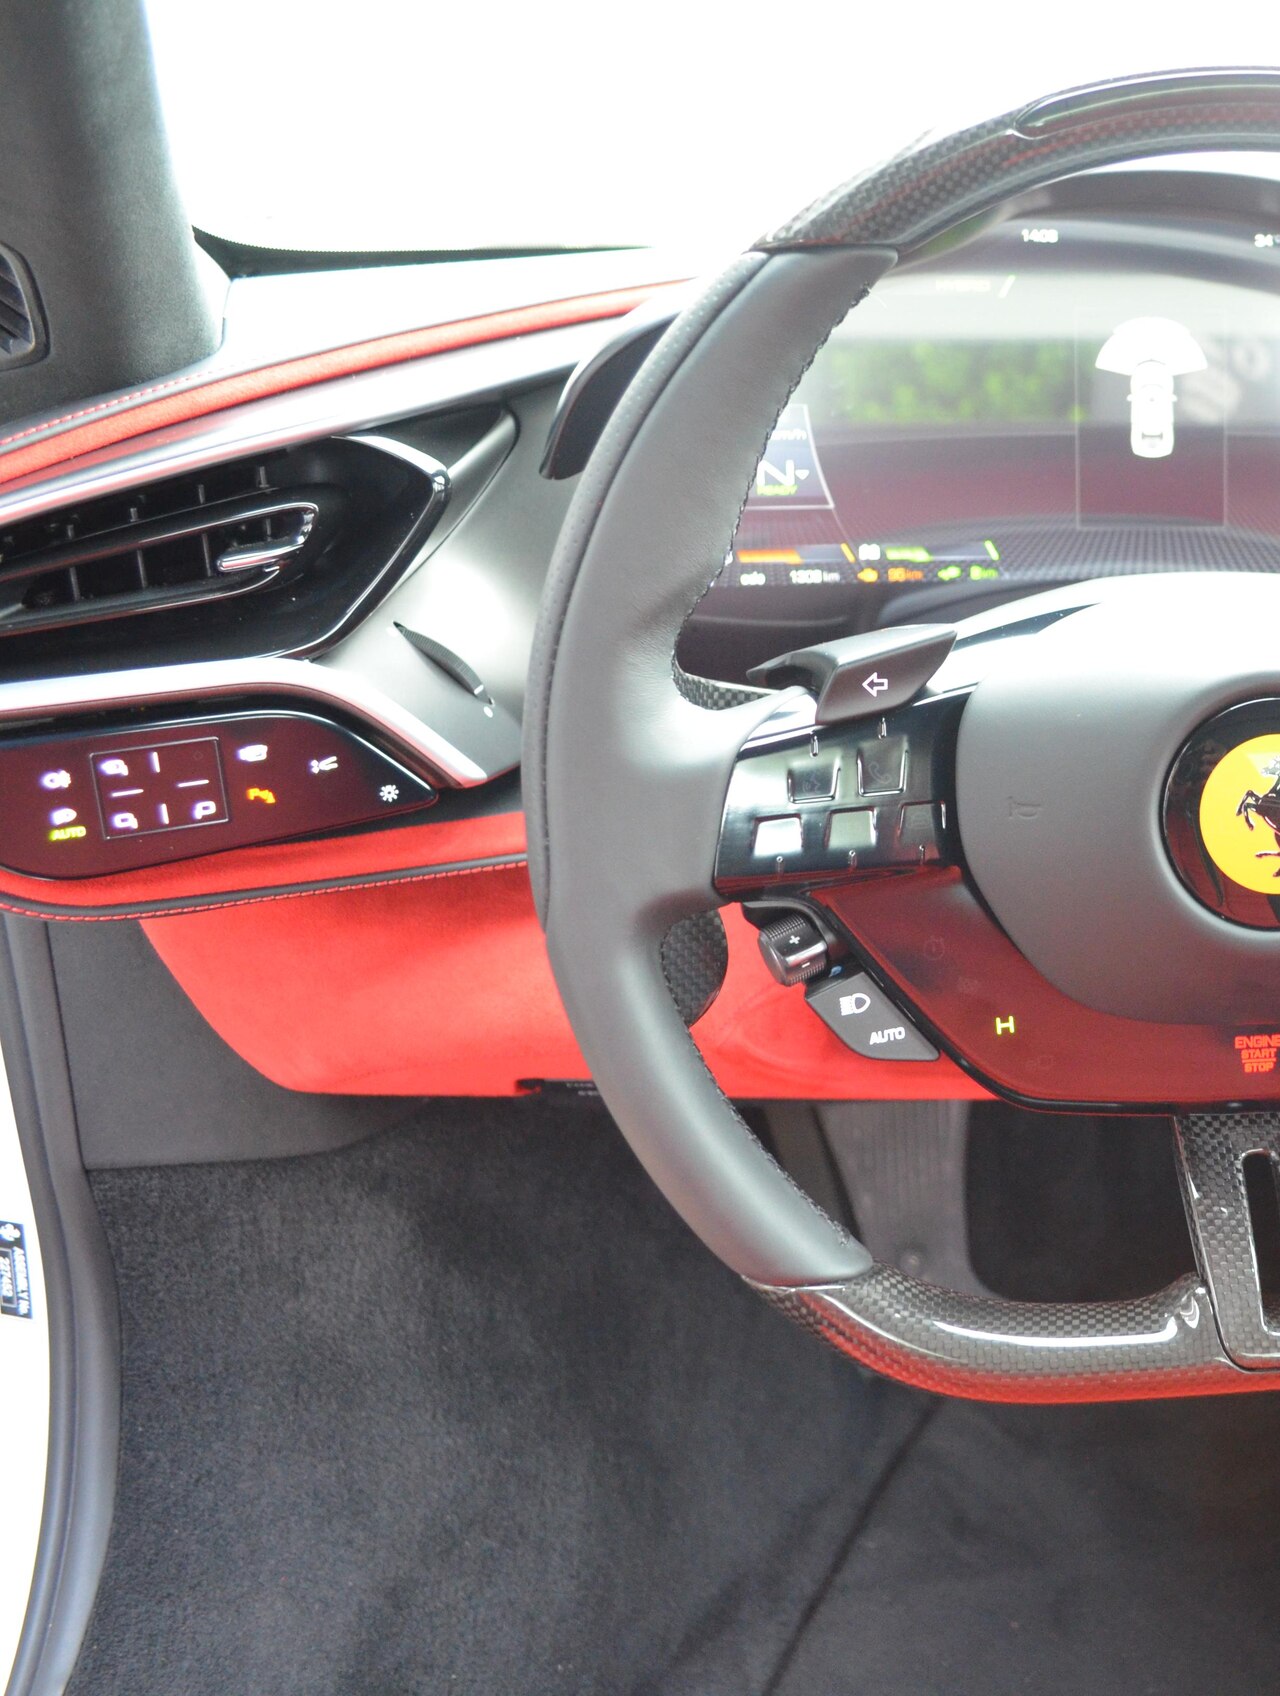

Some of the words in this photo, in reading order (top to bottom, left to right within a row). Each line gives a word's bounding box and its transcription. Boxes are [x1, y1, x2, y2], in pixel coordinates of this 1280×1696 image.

[756, 459, 795, 486] N
[49, 826, 86, 841] AUTO
[995, 1015, 1015, 1035] H
[869, 1026, 905, 1045] AUTO
[1241, 1048, 1277, 1059] START
[1244, 1061, 1275, 1073] STOP
